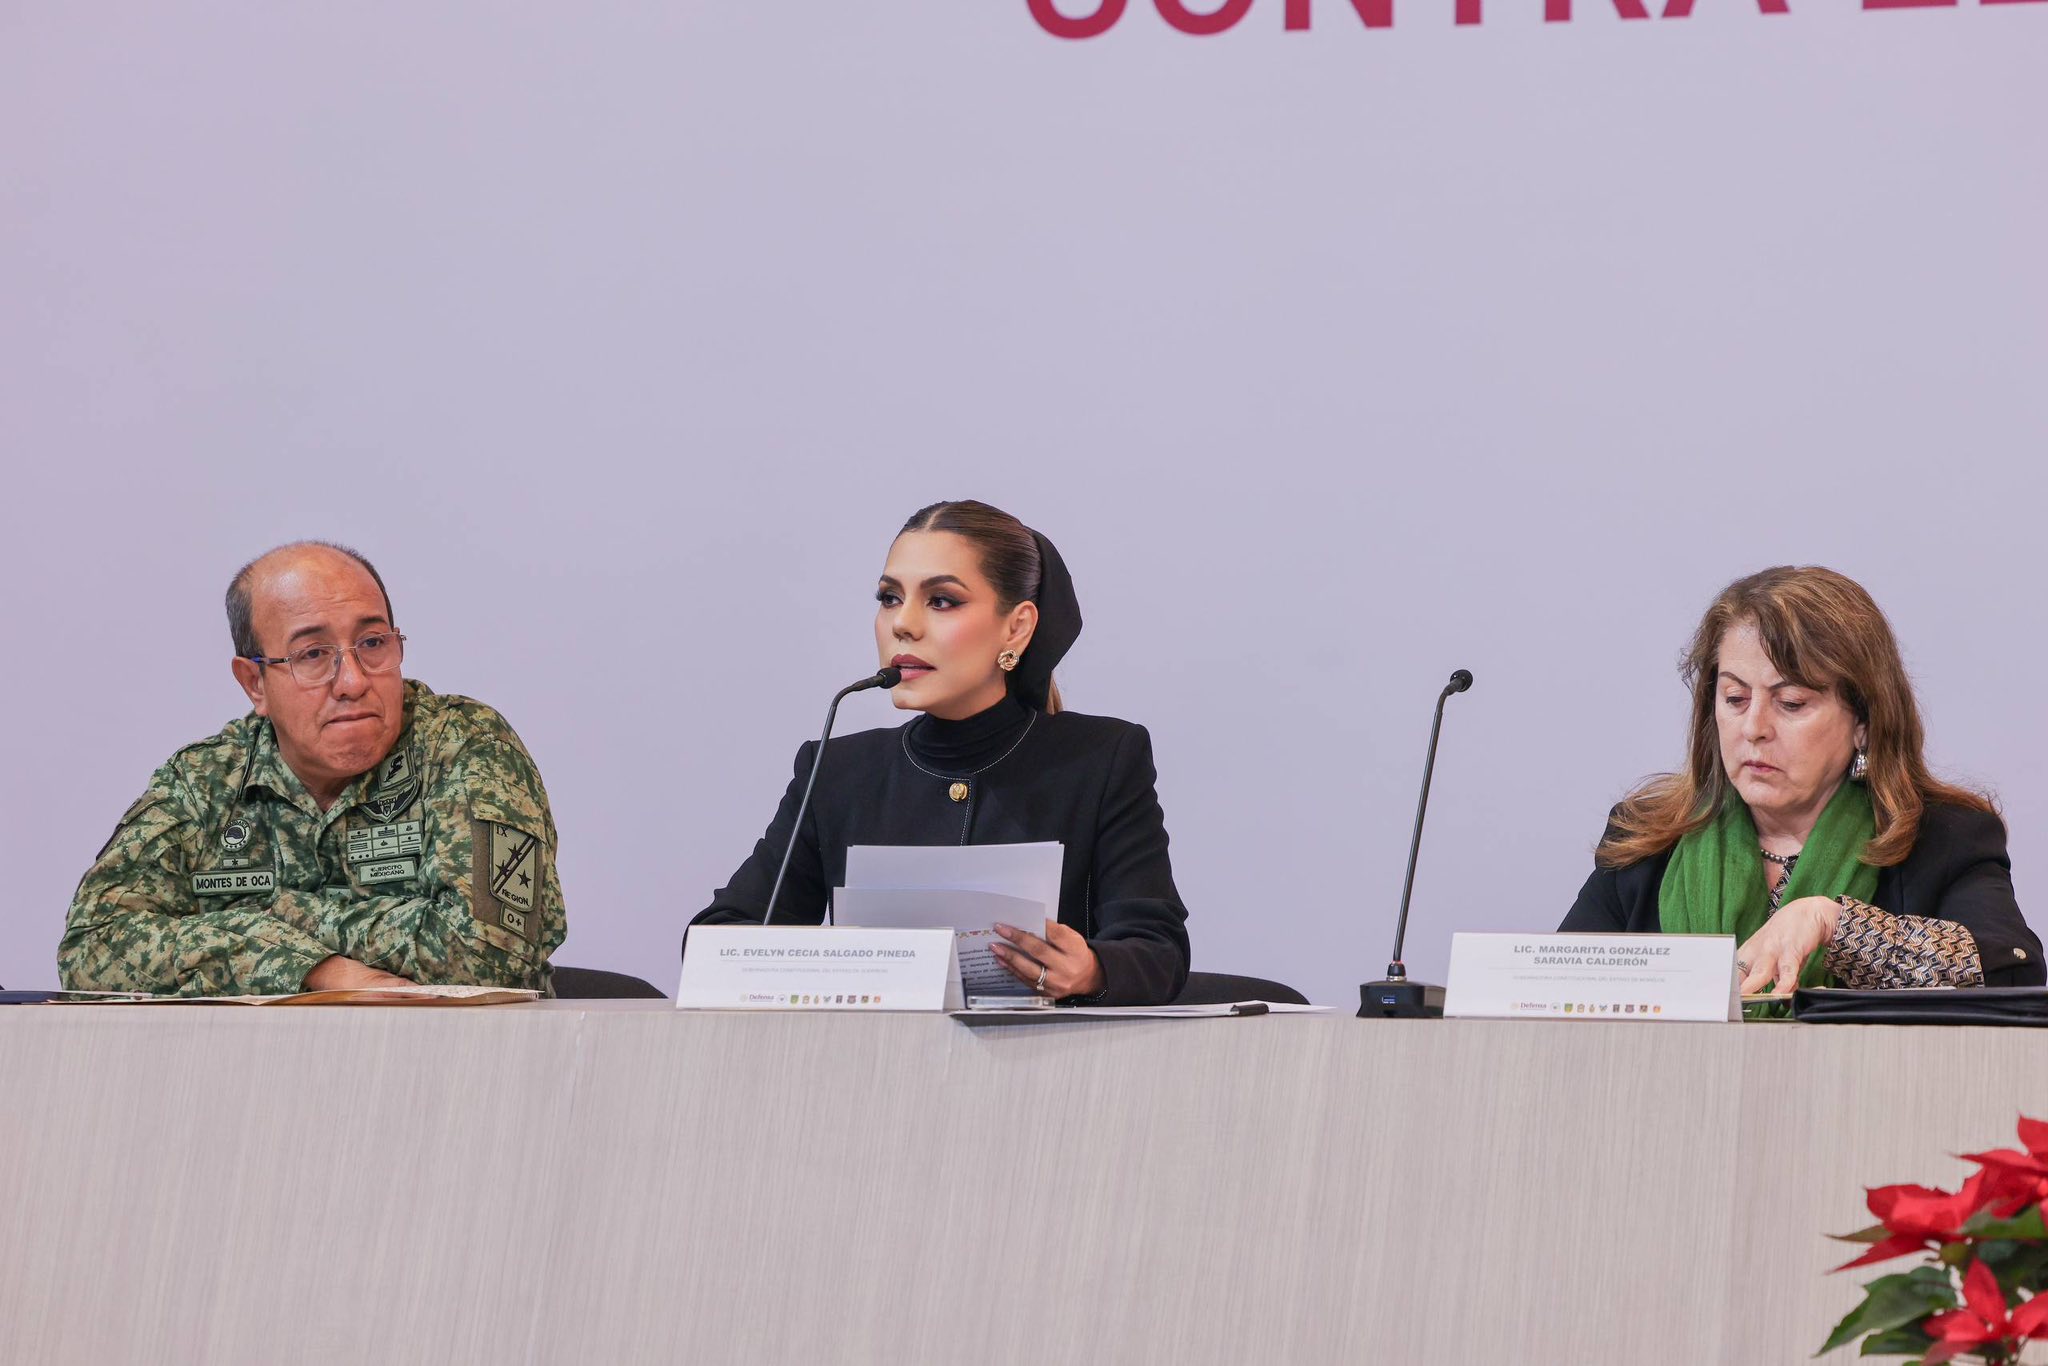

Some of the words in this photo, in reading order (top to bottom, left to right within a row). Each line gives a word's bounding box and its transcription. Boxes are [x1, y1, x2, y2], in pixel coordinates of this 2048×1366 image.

[196, 877, 233, 890] MONTES
[236, 876, 248, 887] DE
[251, 875, 271, 887] OCA
[719, 948, 740, 957] LIC.
[743, 948, 785, 957] EVELYN
[787, 948, 820, 957] CECIA
[822, 949, 874, 958] SALGADO
[876, 949, 916, 958] PINEDA
[1514, 945, 1536, 954] LIC.
[1539, 945, 1606, 955] MARGARITA
[1609, 944, 1671, 956] GONZÁLEZ
[1534, 956, 1583, 965] SARAVIA
[1586, 956, 1648, 967] CALDERÓN
